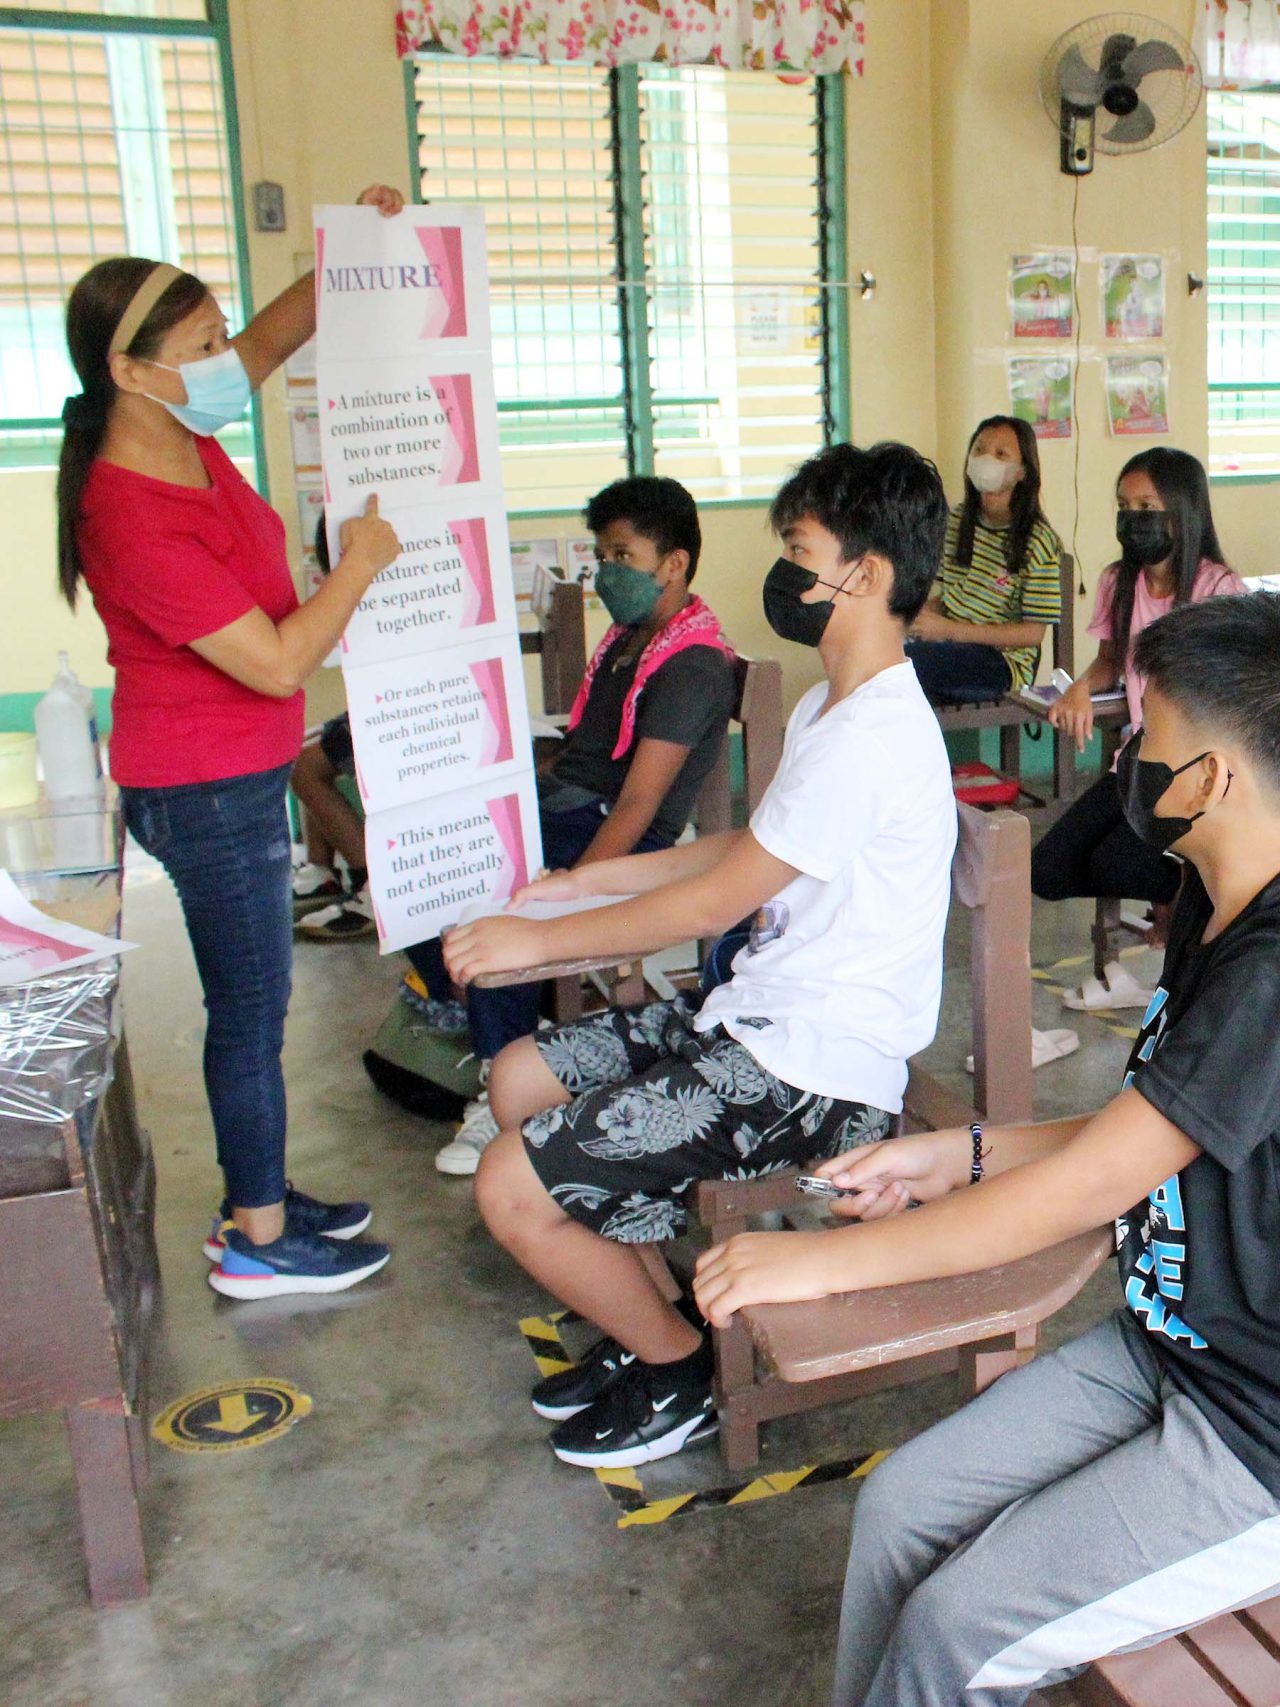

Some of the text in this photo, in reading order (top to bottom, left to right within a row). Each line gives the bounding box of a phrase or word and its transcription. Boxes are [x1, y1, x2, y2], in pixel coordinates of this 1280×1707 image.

[326, 264, 442, 292] MIXTURE
[337, 385, 446, 410] A mixture is a
[331, 407, 453, 437] combination of
[343, 438, 441, 461] two or more
[348, 464, 441, 486] substances.
[445, 530, 462, 546] in
[433, 558, 462, 573] can
[381, 578, 461, 608] separated
[377, 609, 451, 634] together.
[384, 675, 470, 703] Or each pure
[365, 690, 487, 727] substances retains
[378, 708, 480, 743] each individual
[402, 731, 461, 757] chemical
[397, 752, 470, 781] properties.
[397, 813, 491, 848] This means
[392, 835, 495, 873] that they are
[386, 853, 506, 899] not chemically
[407, 879, 491, 917] combined.
